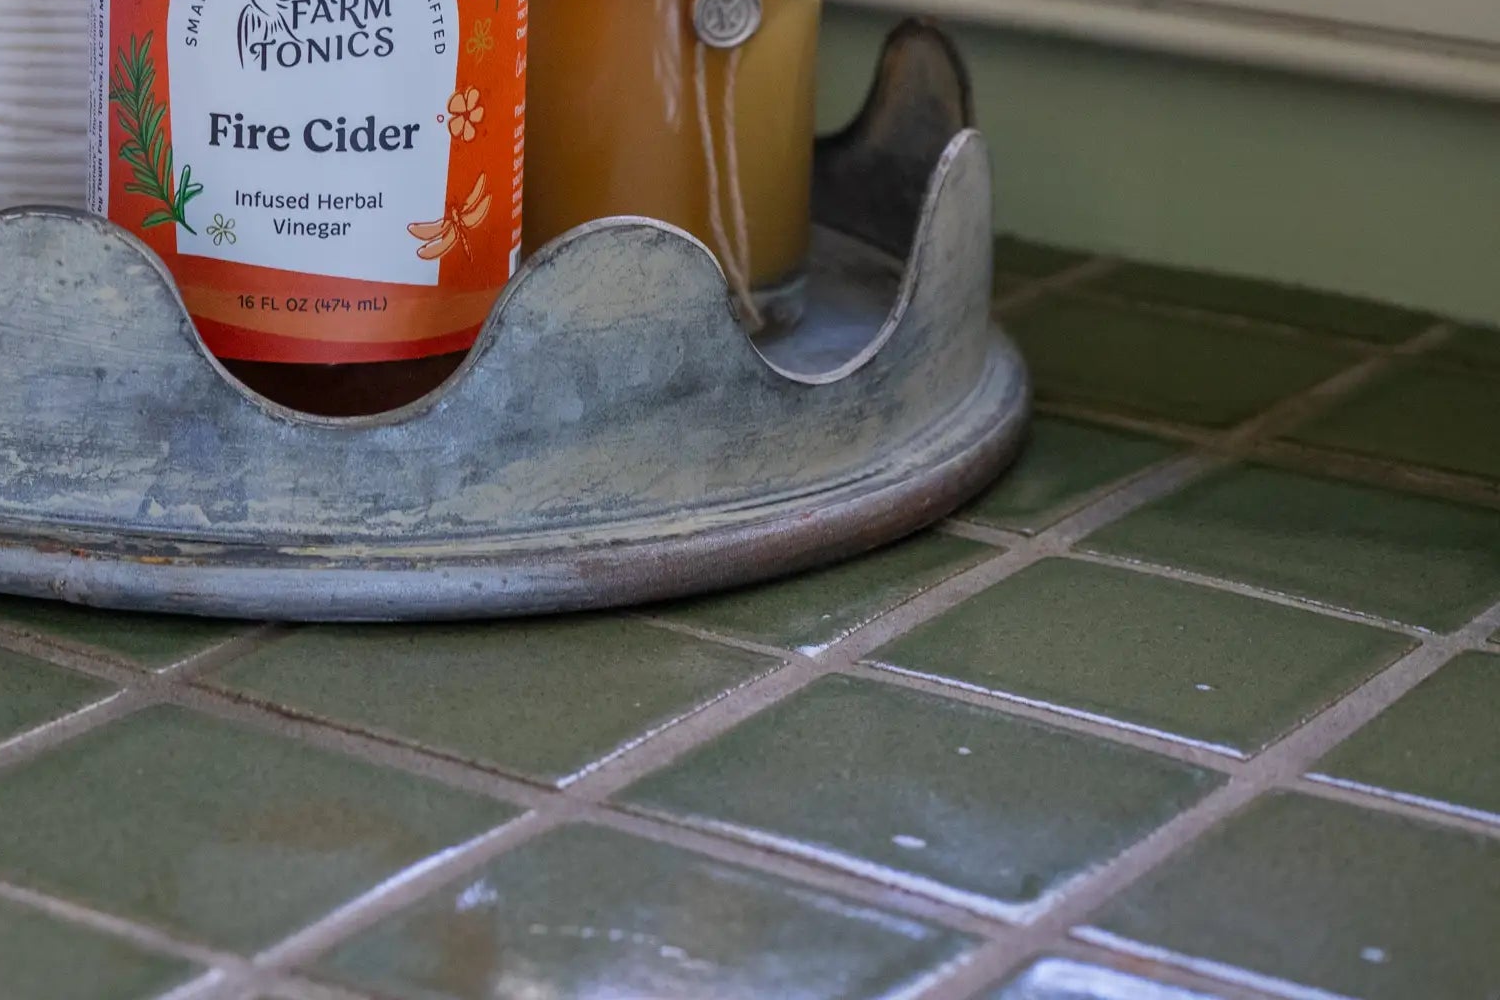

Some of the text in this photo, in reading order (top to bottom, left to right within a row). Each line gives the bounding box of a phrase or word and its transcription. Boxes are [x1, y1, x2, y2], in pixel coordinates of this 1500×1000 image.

[249, 26, 395, 72] TONICS
[209, 112, 420, 153] Fire Cider
[235, 190, 383, 210] Infused Herbal
[273, 219, 352, 239] Vinegar
[237, 294, 388, 314] 16 FL OZ (474 mL)
